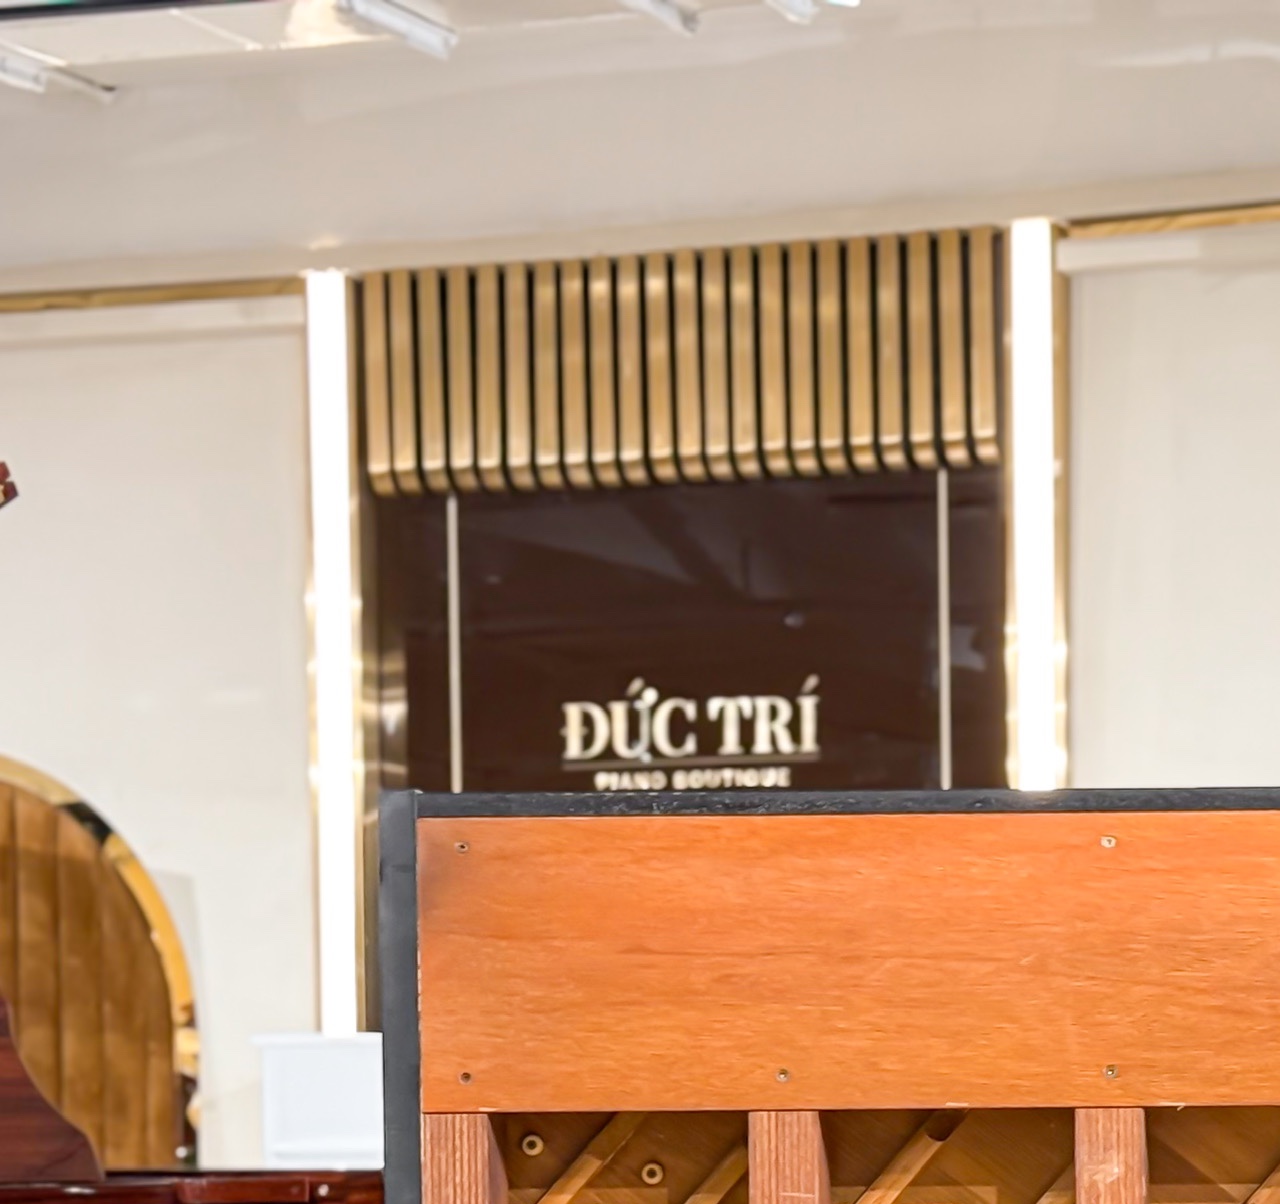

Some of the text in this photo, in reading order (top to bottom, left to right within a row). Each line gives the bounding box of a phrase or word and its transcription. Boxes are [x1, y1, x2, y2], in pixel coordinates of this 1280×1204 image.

[560, 673, 820, 763] ĐỨC TRÍ
[594, 766, 791, 791] PIANO BOUTIQUE
